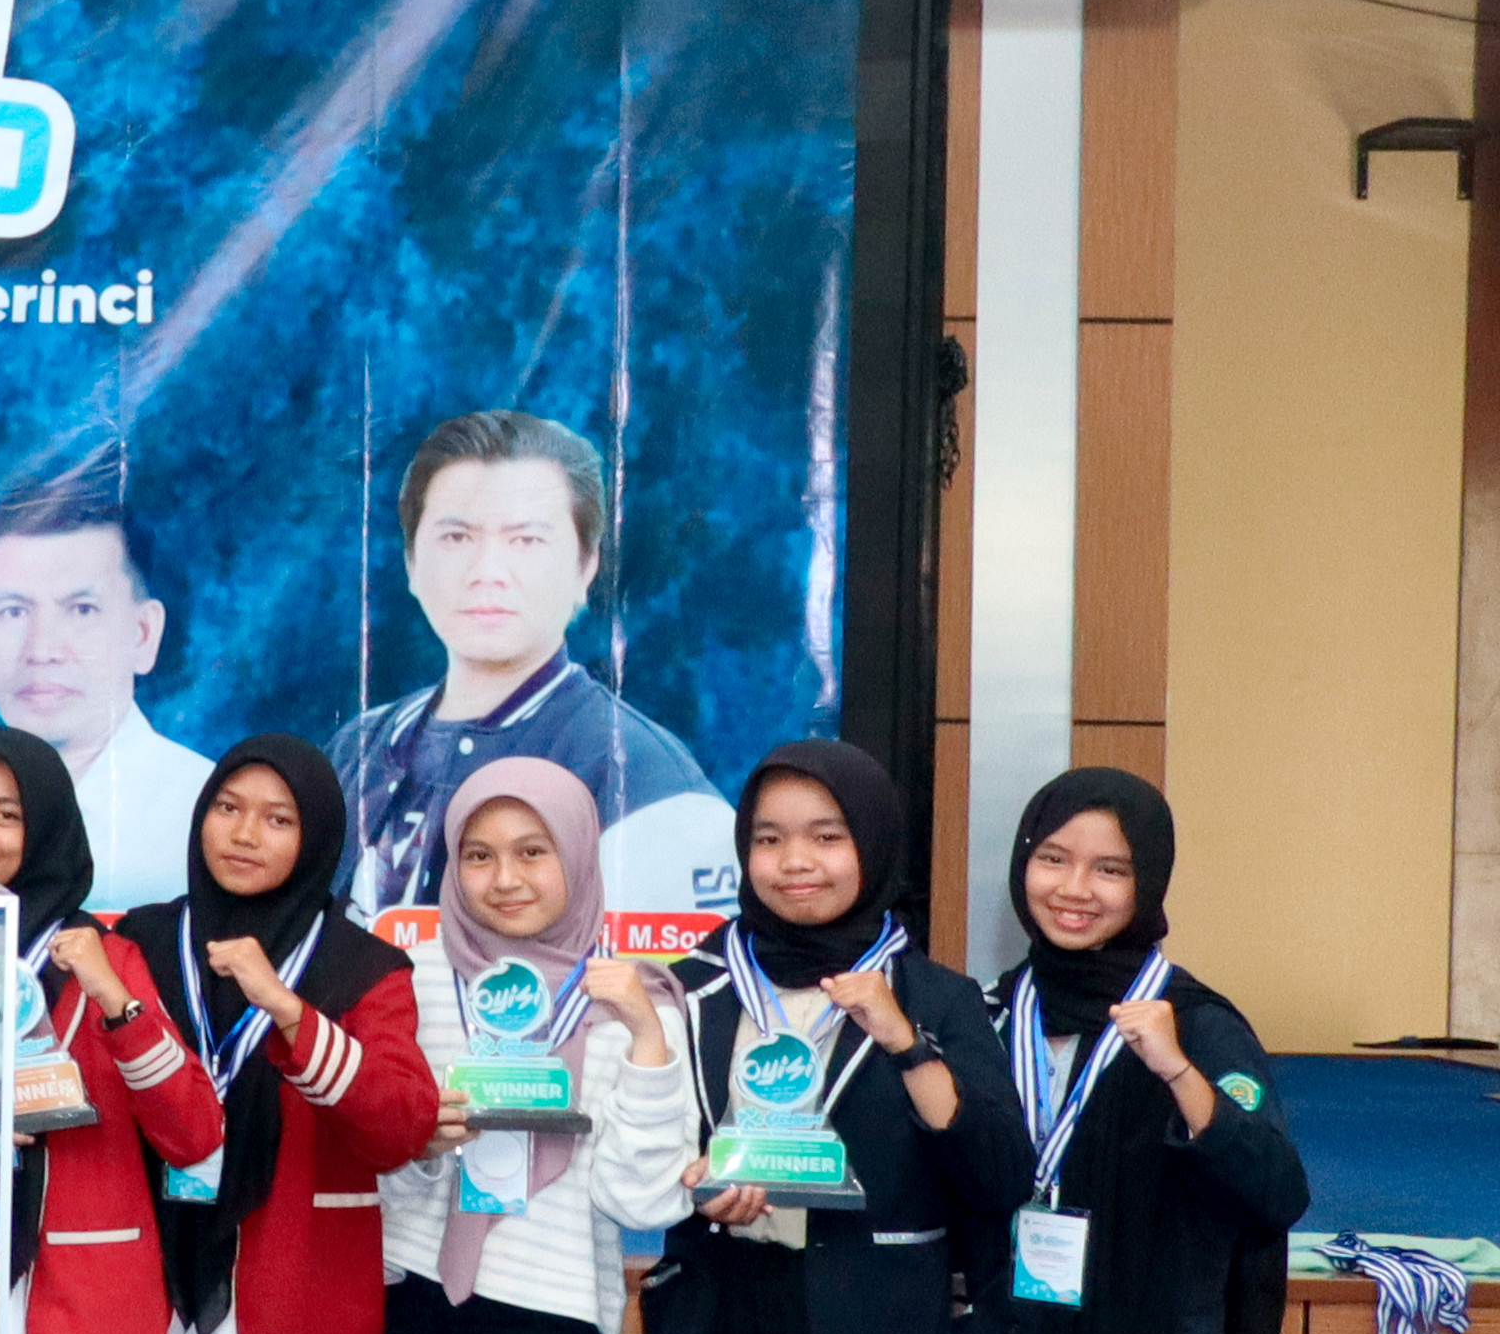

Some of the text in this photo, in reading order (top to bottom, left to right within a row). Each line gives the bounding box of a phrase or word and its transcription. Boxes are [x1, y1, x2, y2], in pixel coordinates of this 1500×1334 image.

[473, 983, 541, 1015] Oyisi
[744, 1055, 814, 1086] Oyisi
[15, 1078, 76, 1104] NNER
[482, 1082, 563, 1099] WINNER
[748, 1154, 836, 1173] WINNER
